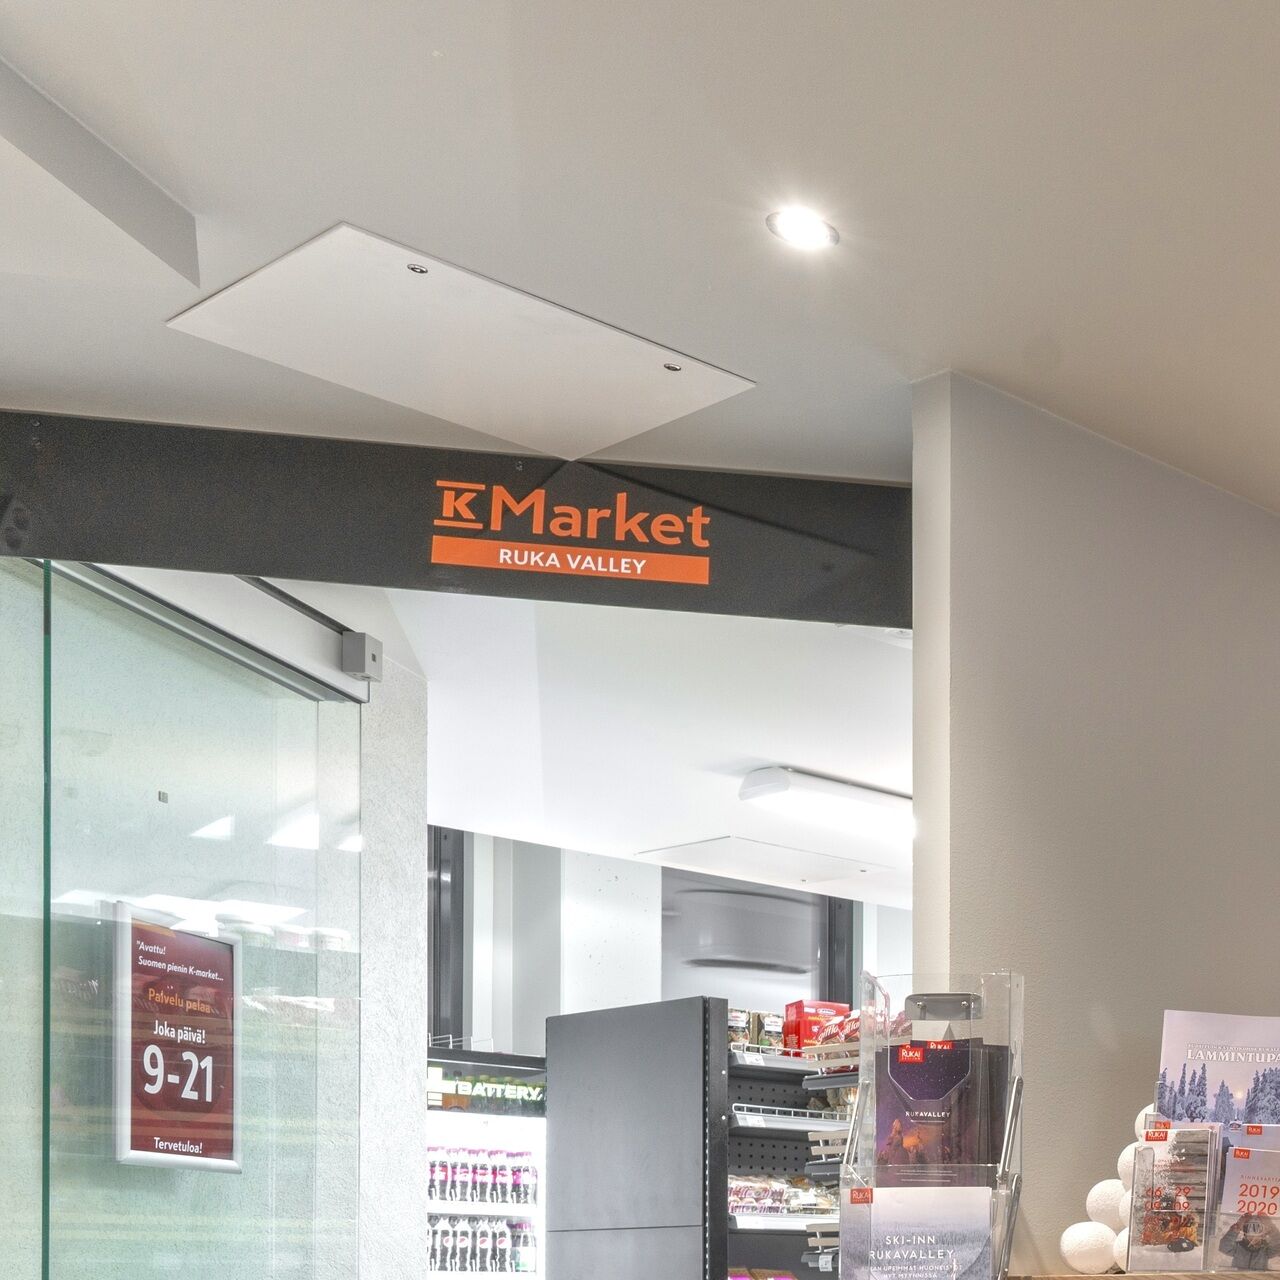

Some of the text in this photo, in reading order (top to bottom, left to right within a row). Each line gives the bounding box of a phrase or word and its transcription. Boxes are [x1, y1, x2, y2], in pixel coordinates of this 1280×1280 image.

[499, 548, 647, 574] RUKA VALLEY
[138, 956, 167, 969] Suomen
[167, 962, 188, 973] pienin
[148, 988, 211, 1014] Palvelu pelaa
[153, 1020, 206, 1044] Joka päivä!
[143, 1044, 213, 1103] 9-21
[457, 1081, 543, 1101] BATTERY
[153, 1136, 203, 1153] Tervetuloa!
[1239, 1183, 1280, 1199] 2019
[1237, 1199, 1278, 1216] 2020
[885, 1235, 936, 1245] SKI-INN
[869, 1249, 954, 1260] RUKAVALLEY
